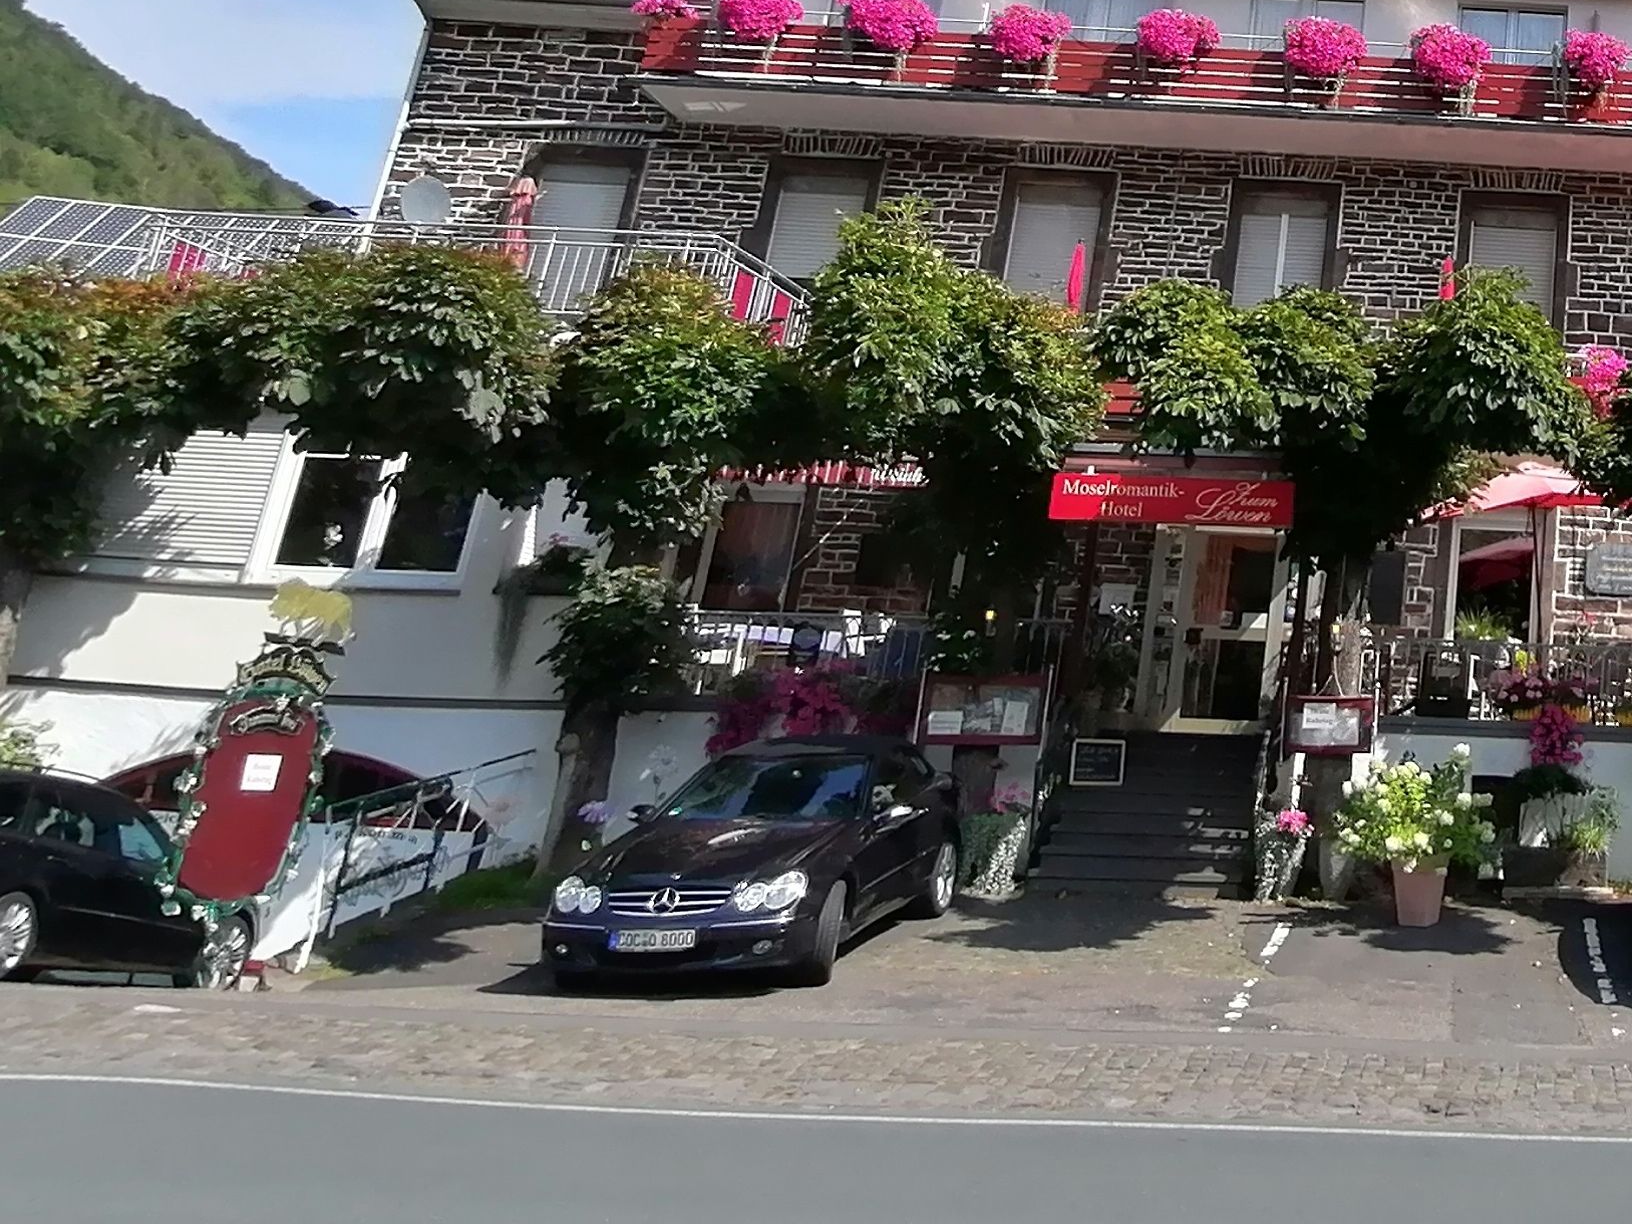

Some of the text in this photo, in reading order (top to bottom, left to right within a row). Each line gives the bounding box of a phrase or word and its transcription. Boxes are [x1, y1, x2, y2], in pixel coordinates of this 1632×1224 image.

[1062, 478, 1185, 498] Moselromantik-
[1230, 482, 1279, 508] Zum
[1100, 500, 1143, 517] Hotel
[1185, 487, 1272, 523] Löwen
[661, 932, 694, 947] 8000
